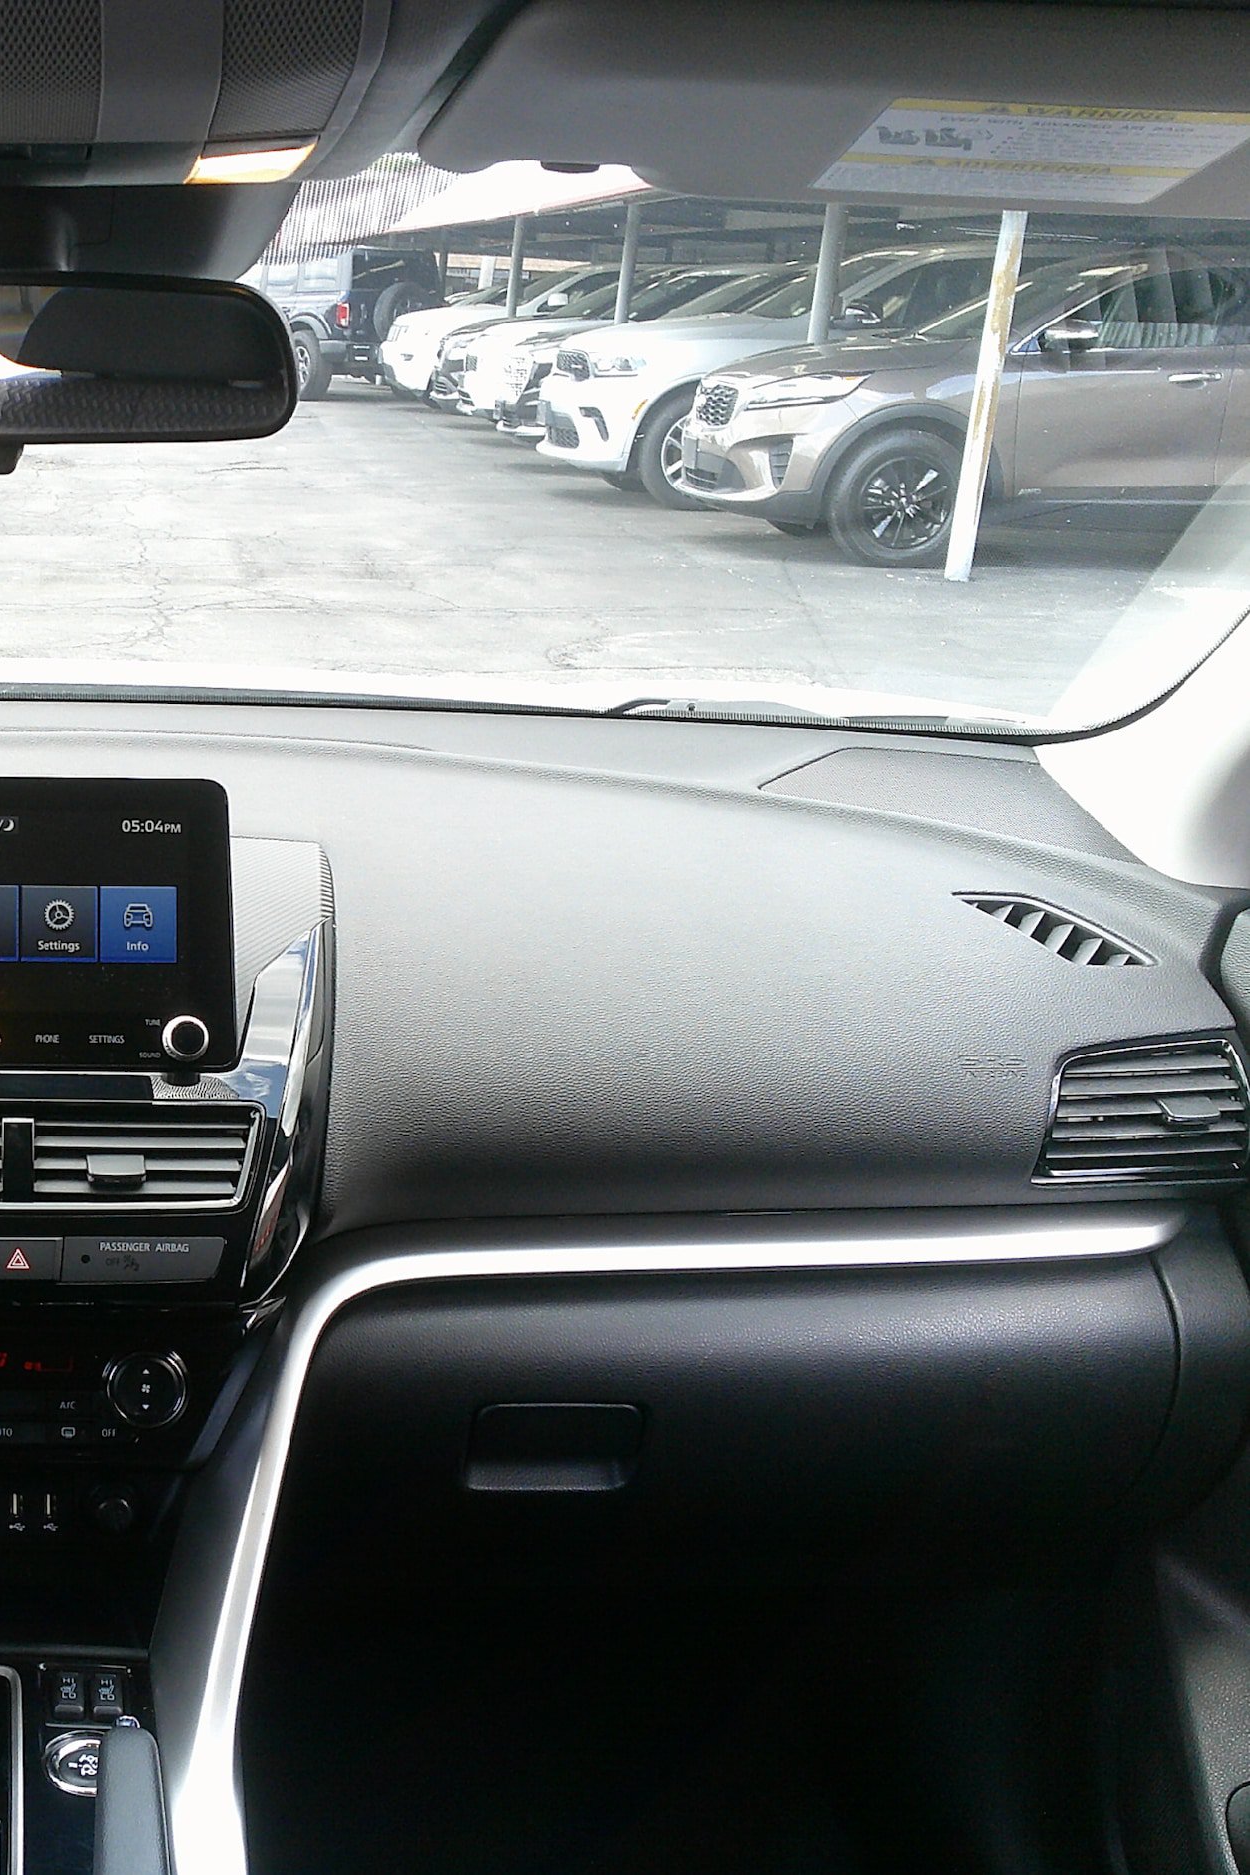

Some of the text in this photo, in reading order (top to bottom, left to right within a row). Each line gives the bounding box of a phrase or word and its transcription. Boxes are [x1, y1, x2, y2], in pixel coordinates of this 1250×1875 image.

[121, 819, 182, 834] 05:04PM
[37, 939, 81, 953] Settings
[125, 940, 150, 953] Info
[35, 1034, 60, 1043] PHONE
[89, 1035, 125, 1044] SETTINGS
[99, 1241, 190, 1253] PASSENGER AIRBAG
[59, 1401, 76, 1410] A/C
[101, 1428, 116, 1438] OFF
